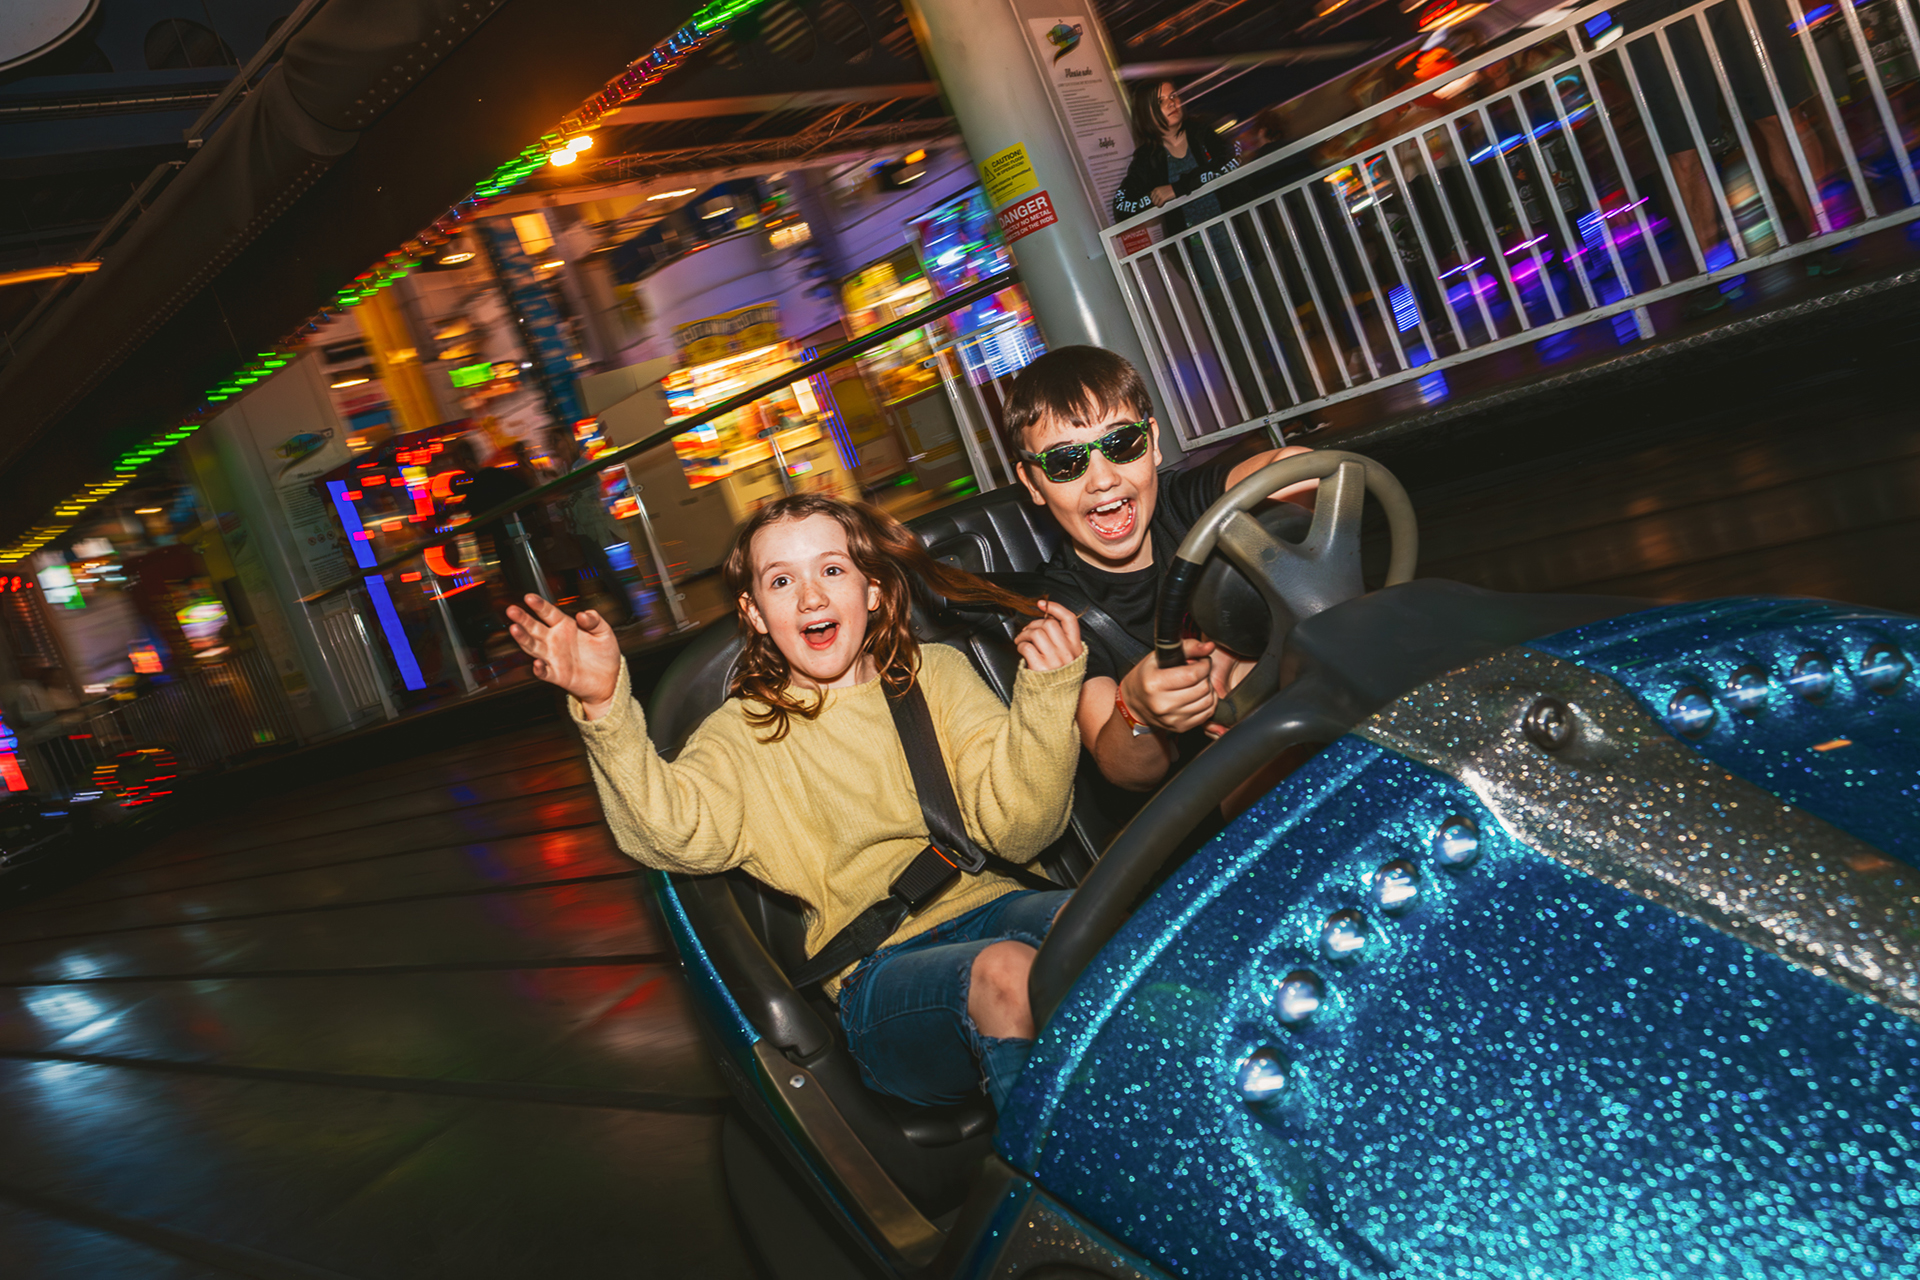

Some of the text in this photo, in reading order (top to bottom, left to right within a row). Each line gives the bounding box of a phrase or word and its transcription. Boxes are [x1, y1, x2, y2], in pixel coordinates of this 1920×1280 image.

[991, 149, 1022, 168] CAUTION!
[998, 196, 1048, 228] DANGER
[1020, 218, 1030, 226] NO
[1030, 209, 1051, 221] METAL
[1029, 221, 1039, 229] THE
[1039, 215, 1054, 224] RIDE
